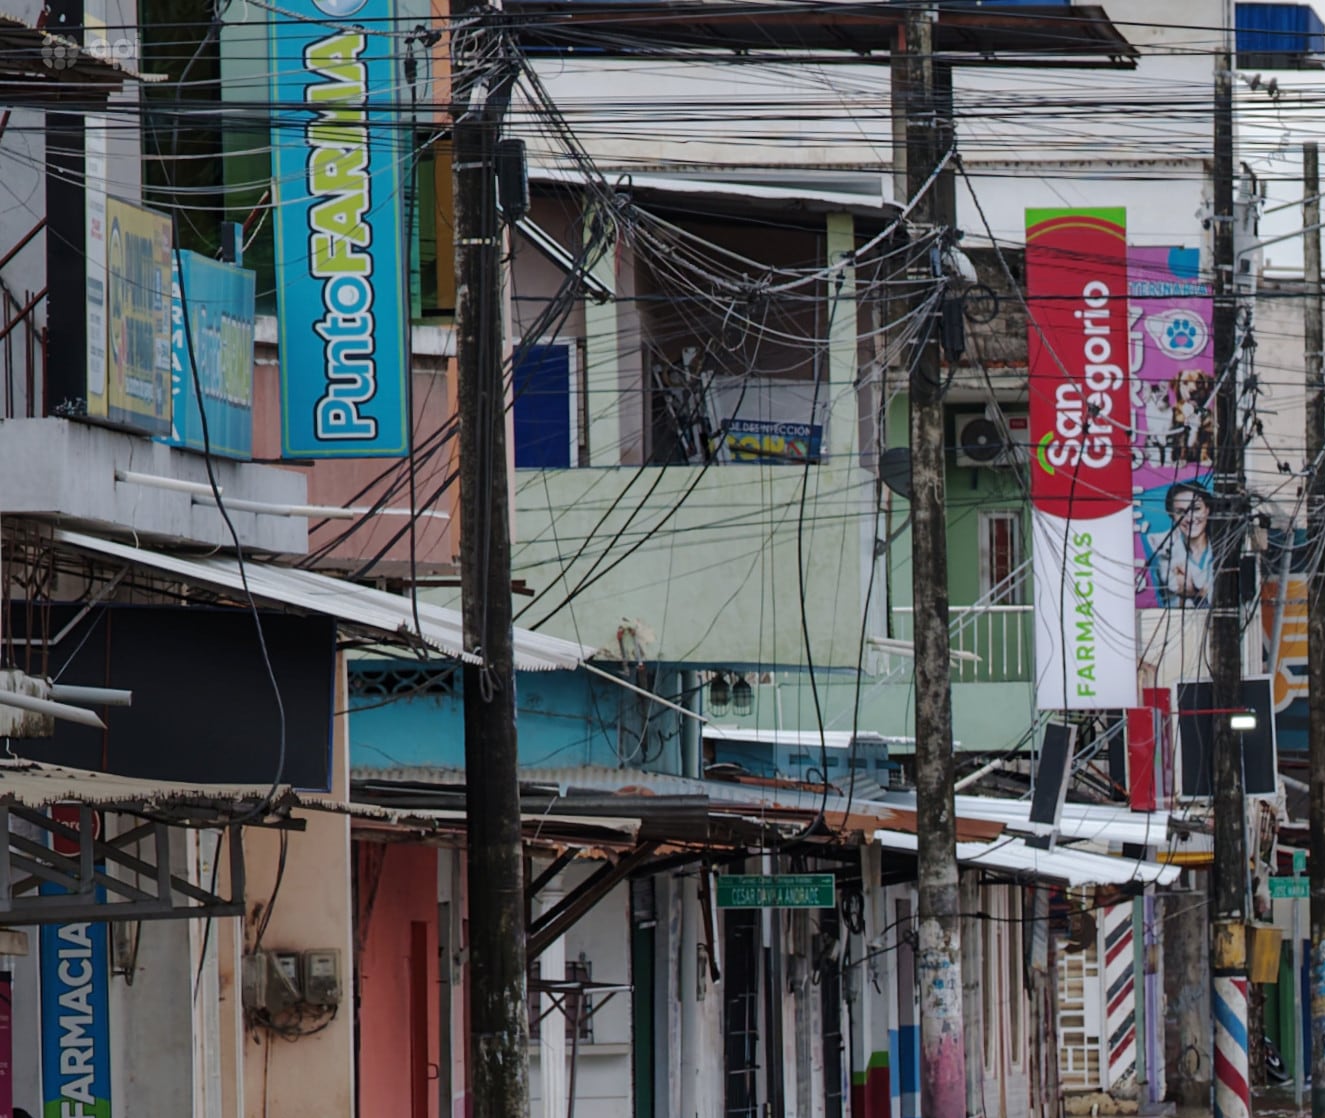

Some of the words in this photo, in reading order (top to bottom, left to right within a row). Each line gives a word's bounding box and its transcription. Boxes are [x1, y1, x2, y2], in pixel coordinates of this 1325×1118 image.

[1047, 383, 1083, 467] San
[1075, 280, 1124, 469] Gregorio
[1076, 531, 1096, 697] FARMACIAS
